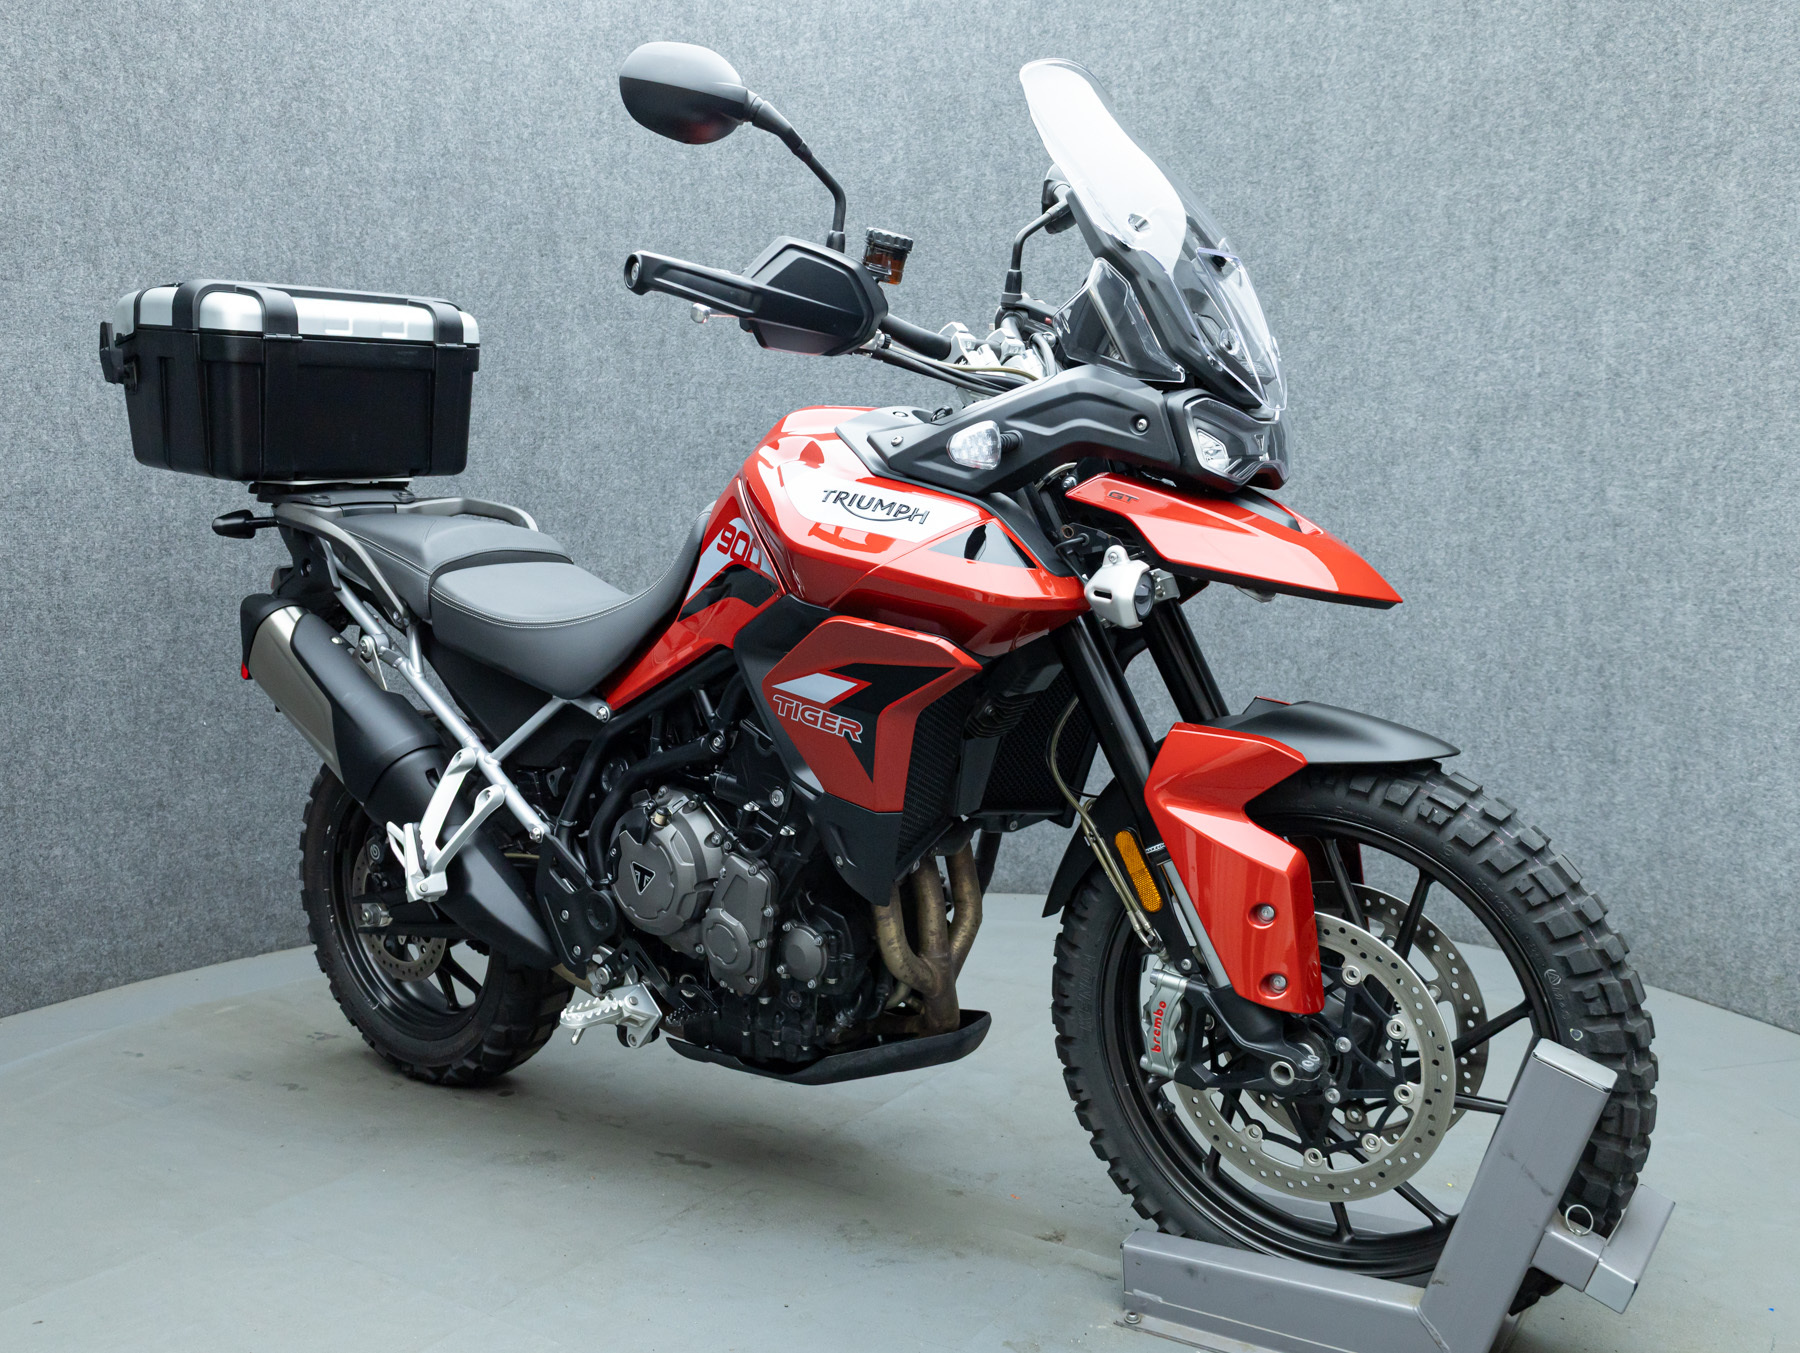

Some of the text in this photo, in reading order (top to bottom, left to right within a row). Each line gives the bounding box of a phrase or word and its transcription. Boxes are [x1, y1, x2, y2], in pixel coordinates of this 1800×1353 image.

[822, 489, 931, 525] TRIUMPH
[1108, 491, 1140, 503] GT
[772, 694, 864, 744] TIGER
[1151, 1000, 1167, 1053] brembo
